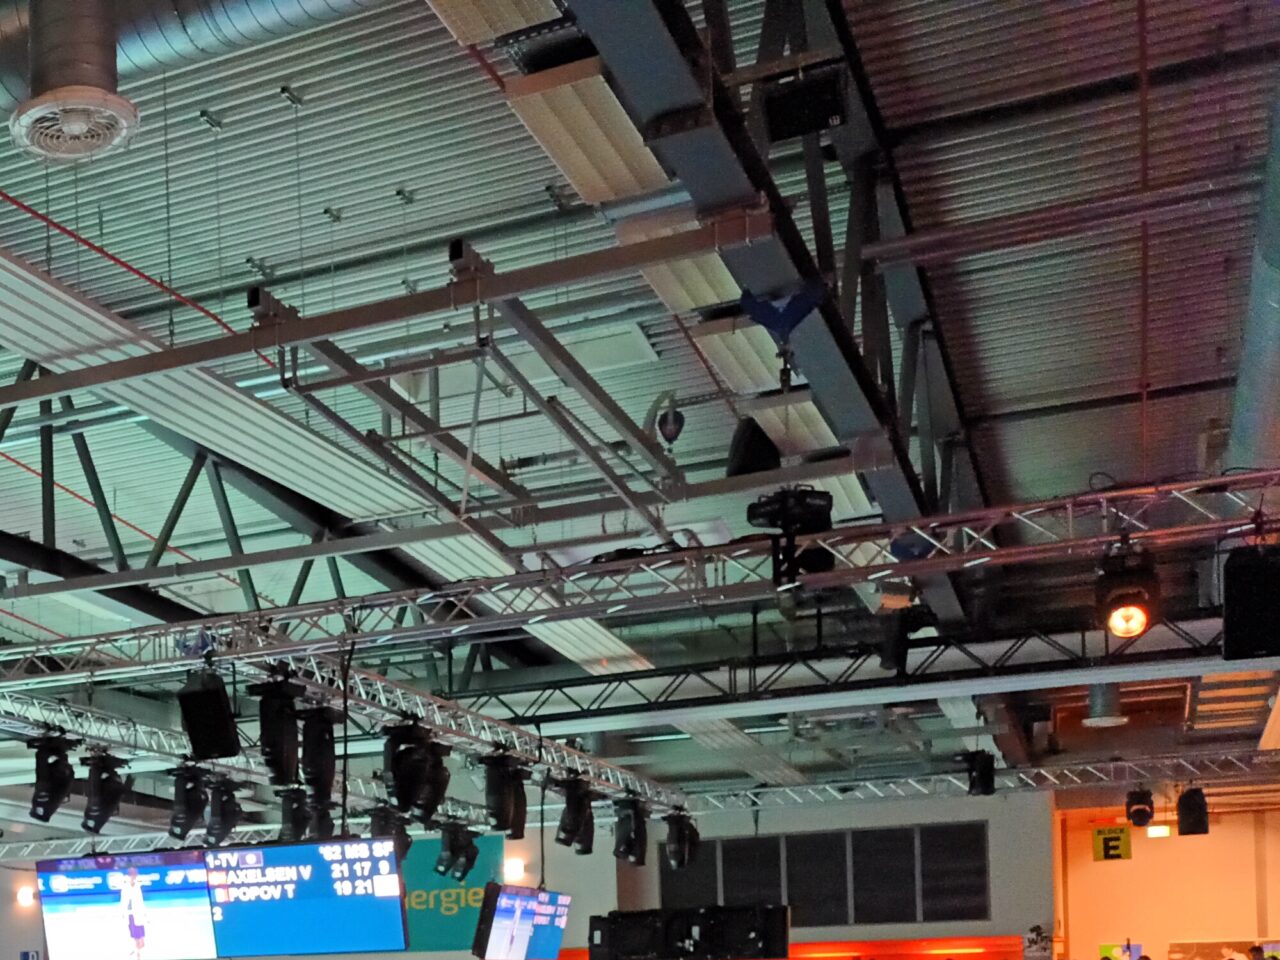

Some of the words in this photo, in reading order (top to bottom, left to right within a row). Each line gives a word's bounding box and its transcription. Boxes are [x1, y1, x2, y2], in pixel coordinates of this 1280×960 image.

[372, 841, 395, 857] SF
[1103, 836, 1122, 860] E
[226, 865, 297, 884] AXELSEN
[299, 865, 312, 880] V
[331, 862, 349, 879] 21
[353, 861, 371, 877] 17
[228, 884, 282, 902] POPOV
[284, 883, 296, 899] T
[354, 879, 372, 895] 21
[212, 906, 223, 921] 2
